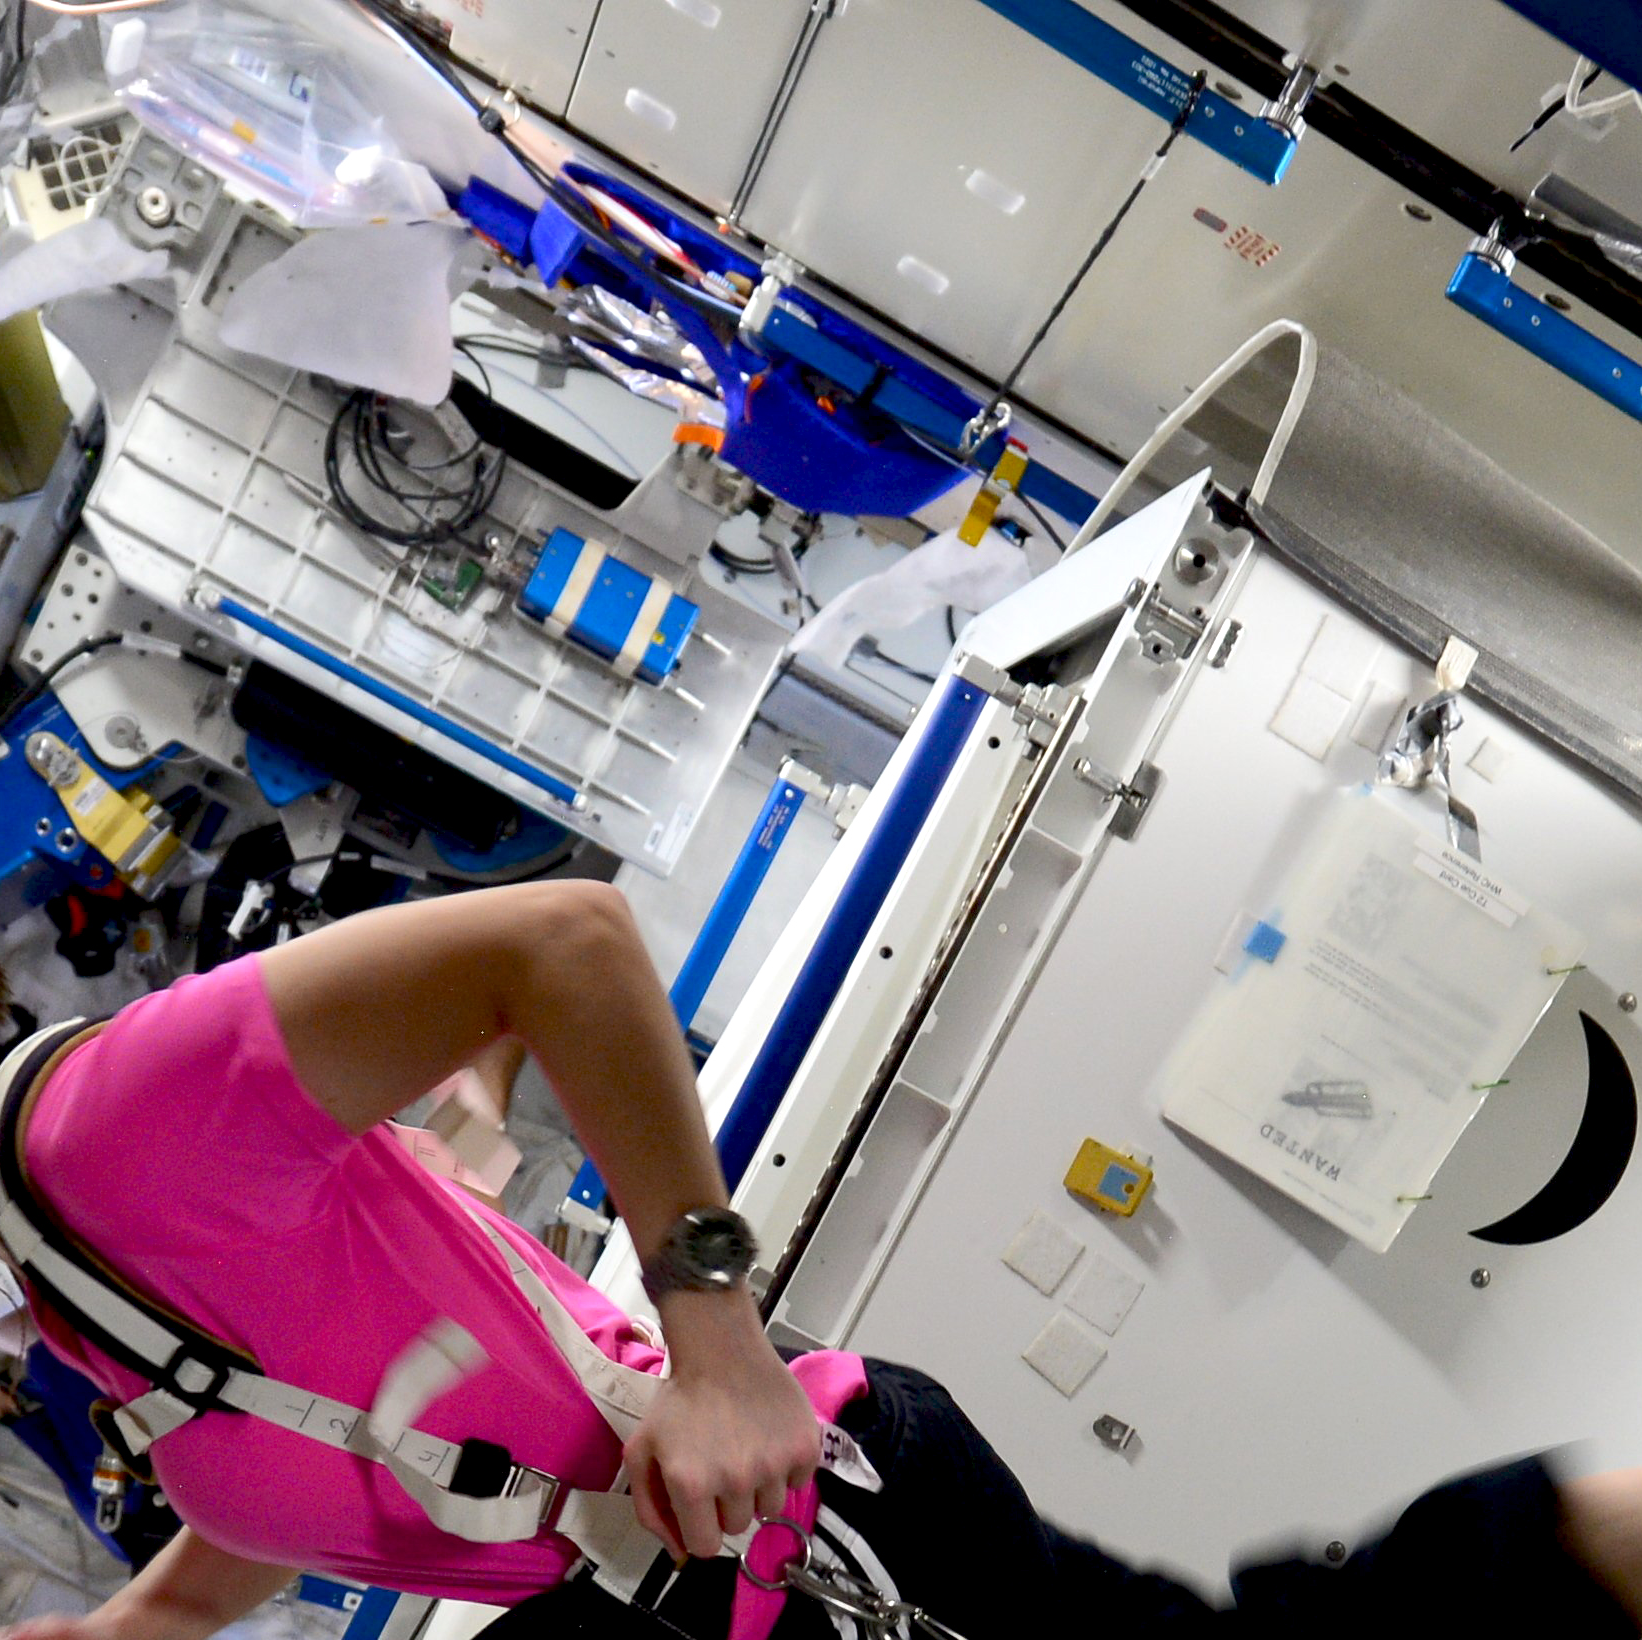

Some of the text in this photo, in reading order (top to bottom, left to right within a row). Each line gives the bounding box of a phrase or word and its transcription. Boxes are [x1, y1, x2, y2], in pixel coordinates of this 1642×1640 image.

[1441, 850, 1480, 883] Reference
[1438, 868, 1461, 889] Card
[1459, 883, 1478, 899] Cue
[1259, 1123, 1341, 1182] WANTED
[328, 1416, 354, 1435] 2
